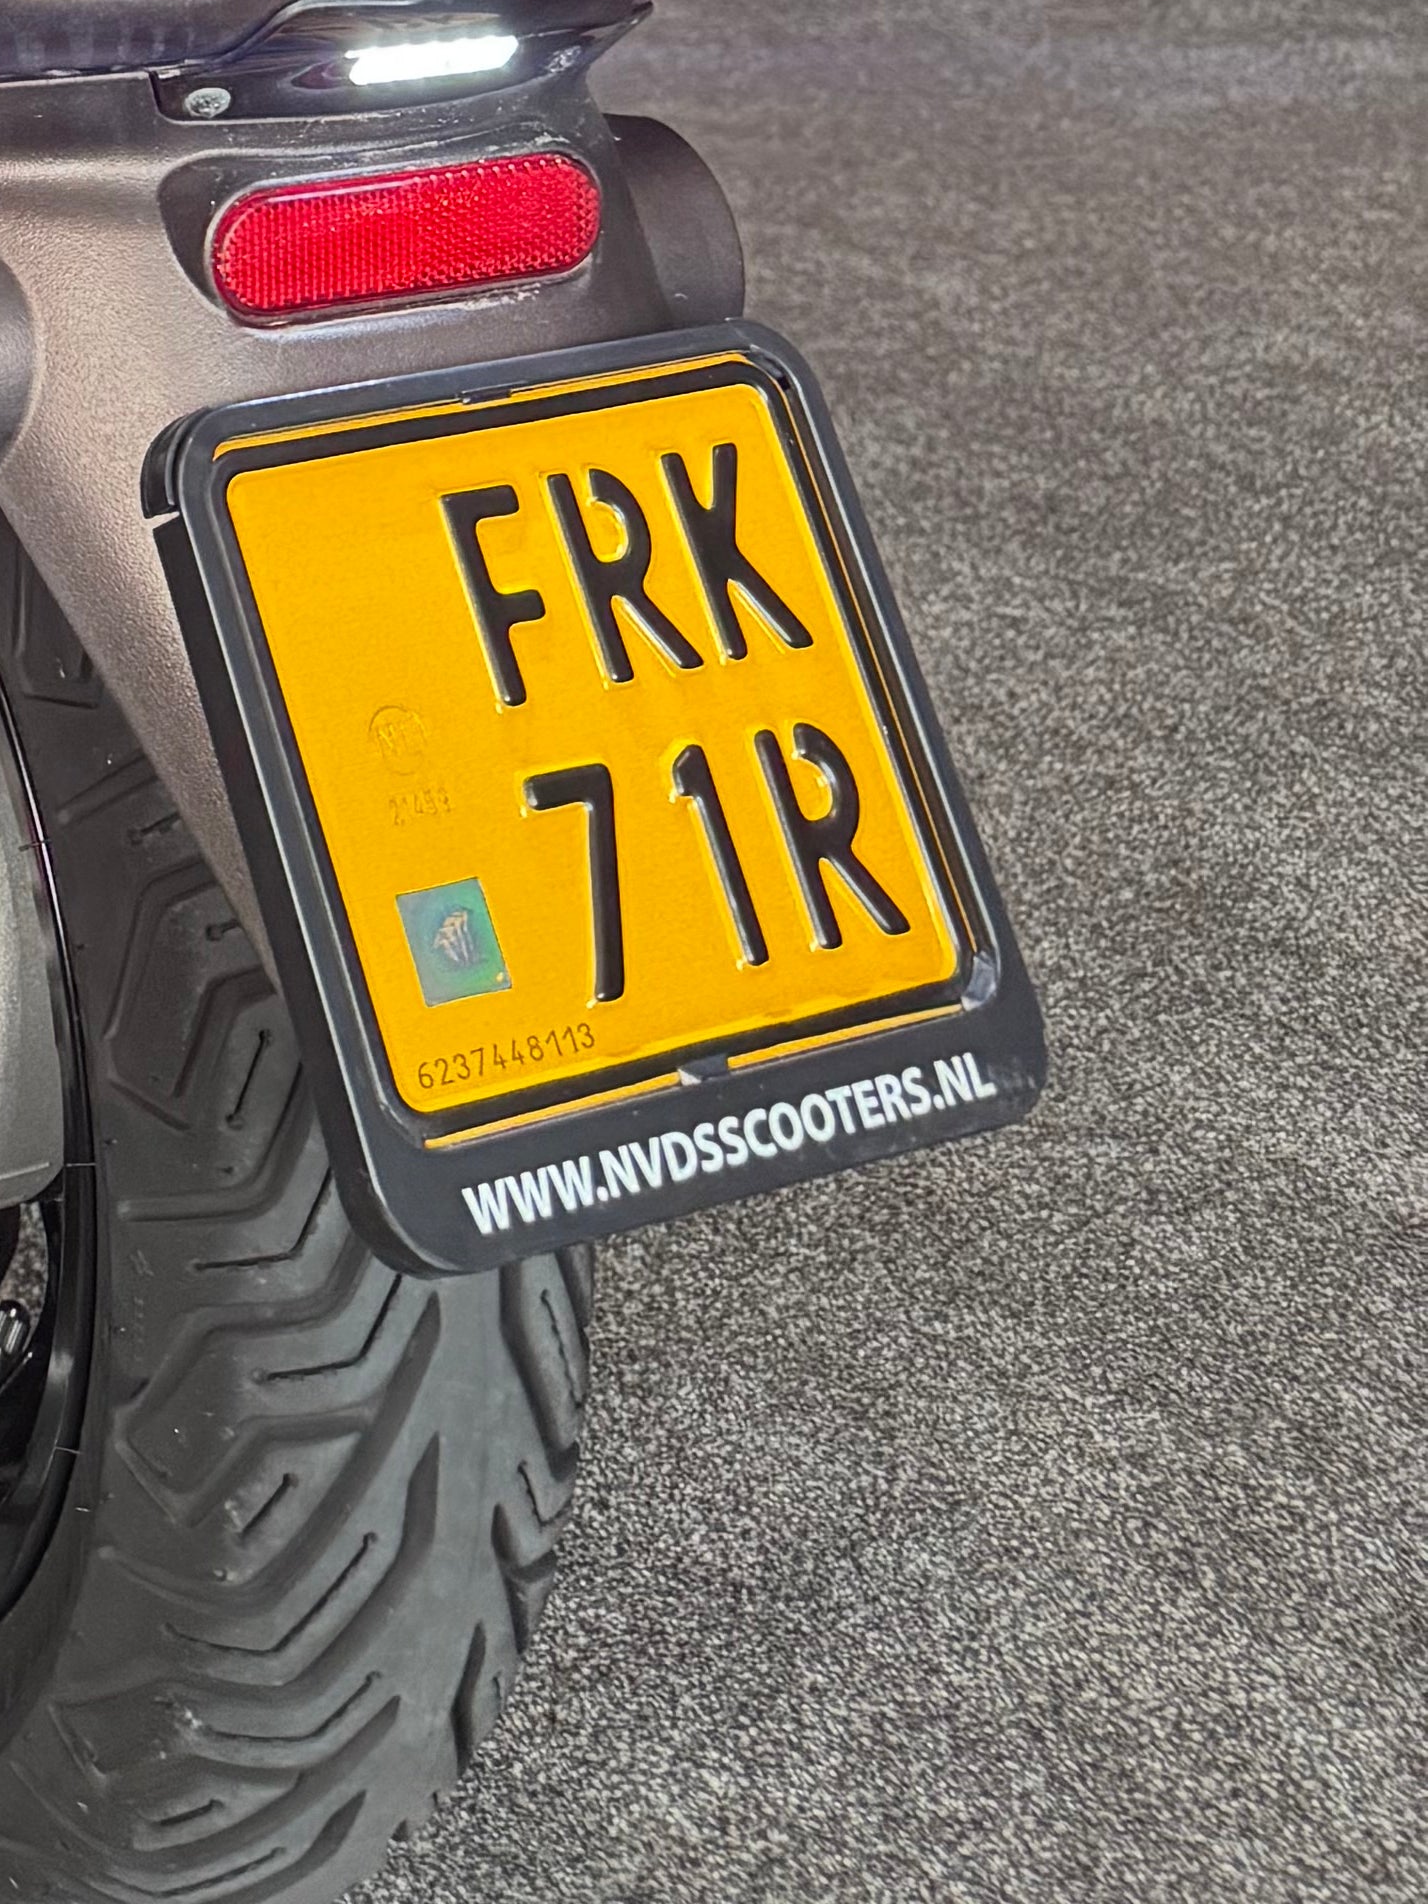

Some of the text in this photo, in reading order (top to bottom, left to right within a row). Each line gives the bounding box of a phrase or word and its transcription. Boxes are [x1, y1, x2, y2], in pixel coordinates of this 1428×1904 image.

[437, 441, 814, 710] FRK
[519, 721, 910, 1005] 71R
[417, 1022, 596, 1090] 6237448113
[462, 1052, 998, 1235] WWW.NVDSSCOOTERS.NL
